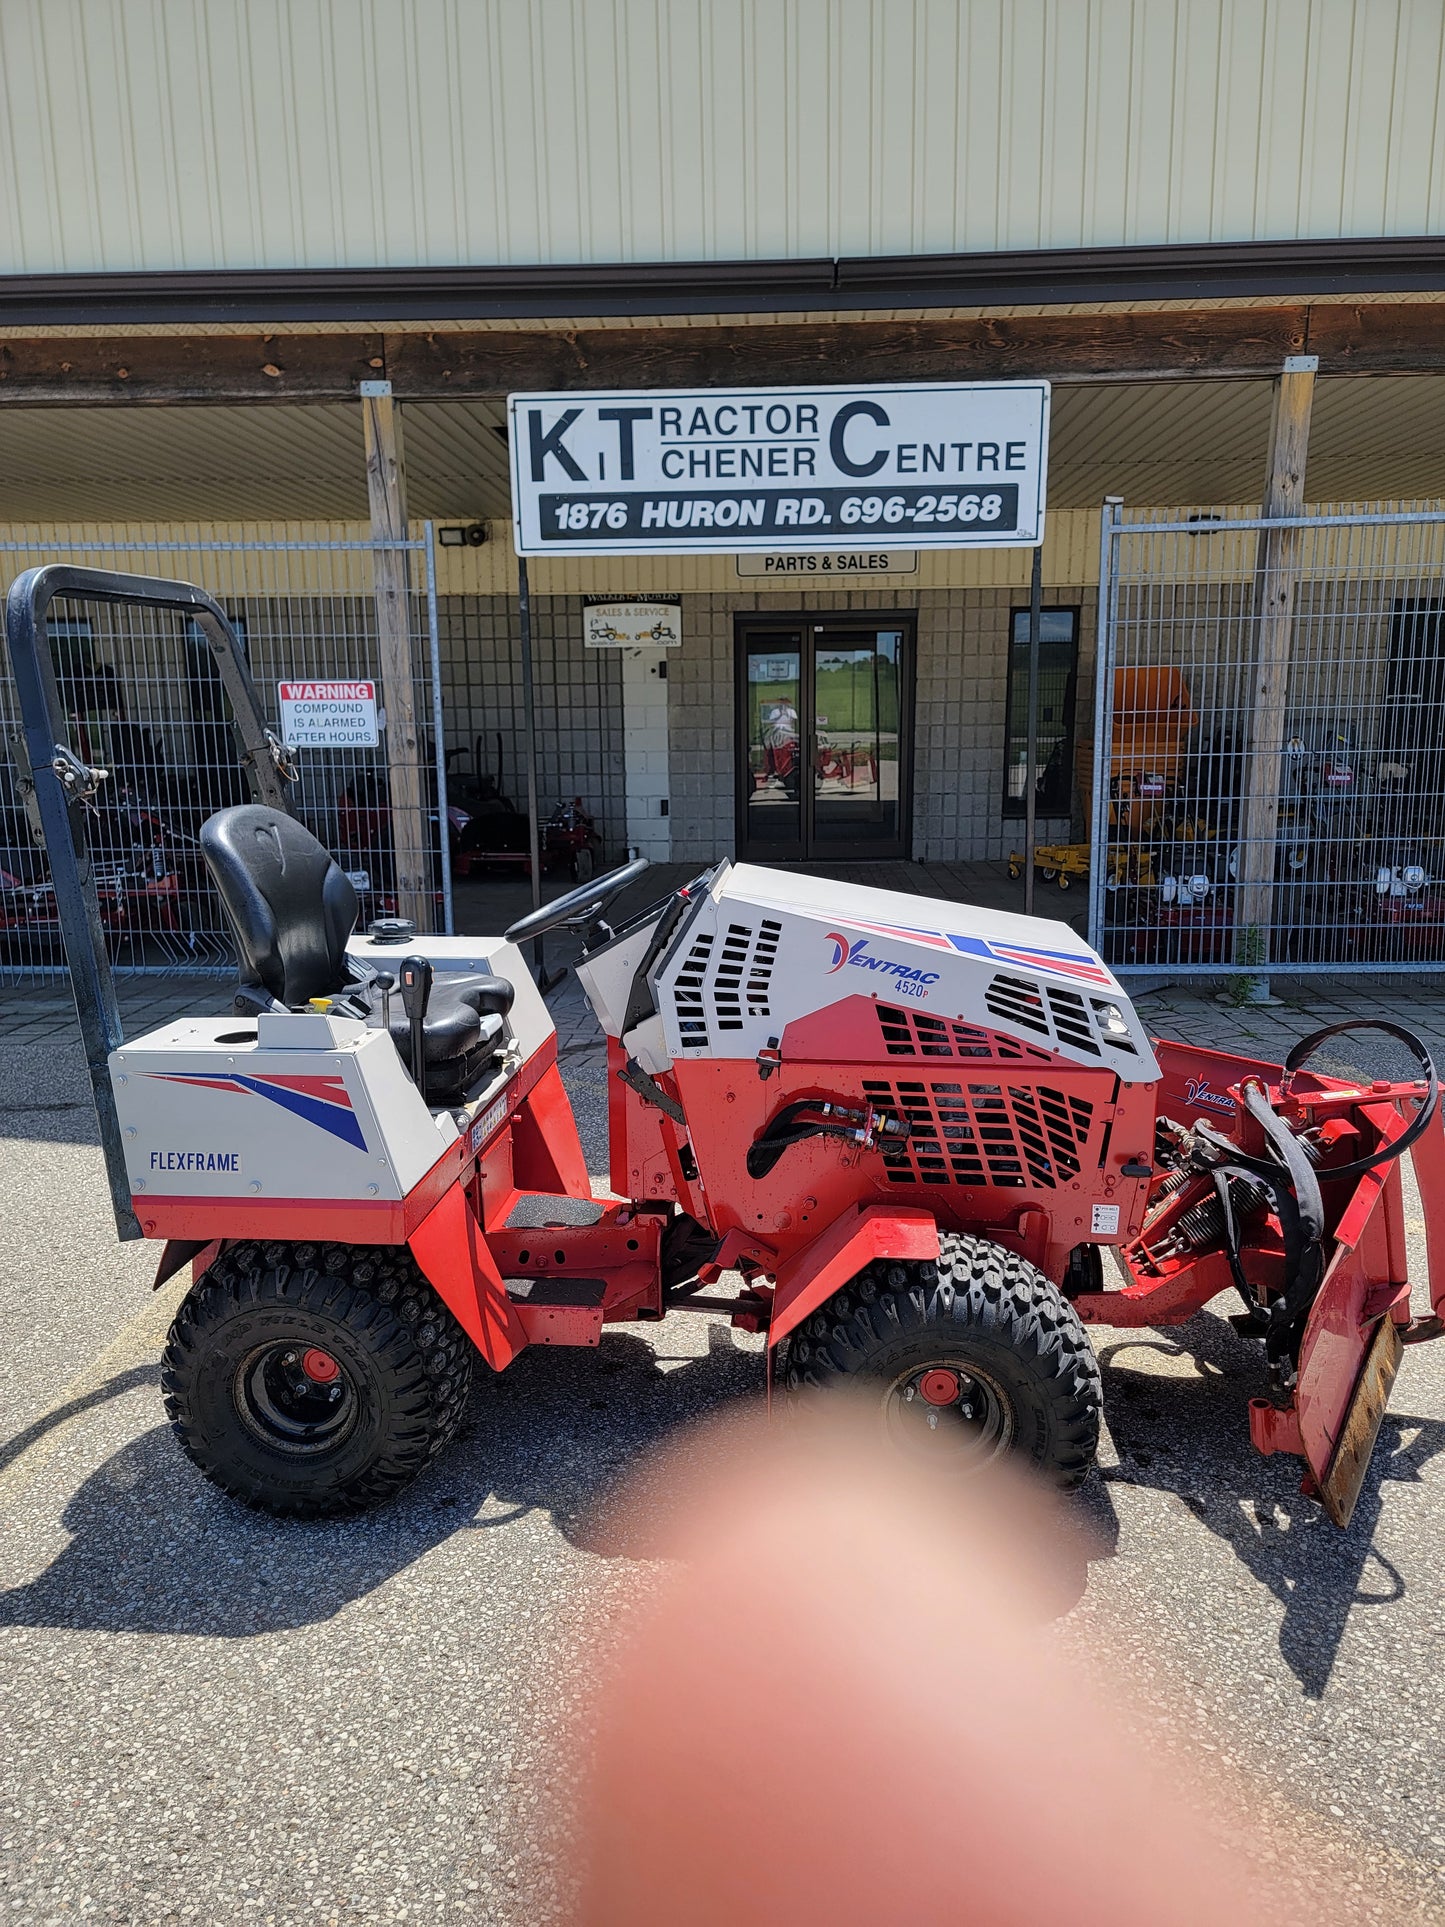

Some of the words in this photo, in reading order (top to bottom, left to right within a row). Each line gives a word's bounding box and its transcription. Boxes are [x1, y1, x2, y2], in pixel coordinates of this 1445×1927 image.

[829, 400, 1027, 478] CENTRE
[554, 501, 628, 530] 1876
[641, 498, 765, 528] HURON
[774, 497, 832, 525] RD.
[839, 494, 1002, 524] 696-2568
[765, 555, 817, 571] PARTS
[821, 555, 832, 570] &
[837, 554, 889, 570] SALES
[595, 608, 622, 617] SALES
[624, 608, 631, 617] &
[634, 607, 670, 617] SERVICE
[286, 684, 369, 699] WARNING
[294, 703, 364, 714] COMPOUND
[293, 718, 305, 728] IS
[308, 717, 366, 728] ALARMED
[288, 732, 326, 742] AFTER
[329, 731, 375, 742] HOURS.
[824, 932, 940, 985] VENTRAC
[150, 1151, 239, 1172] FLEXFRAME
